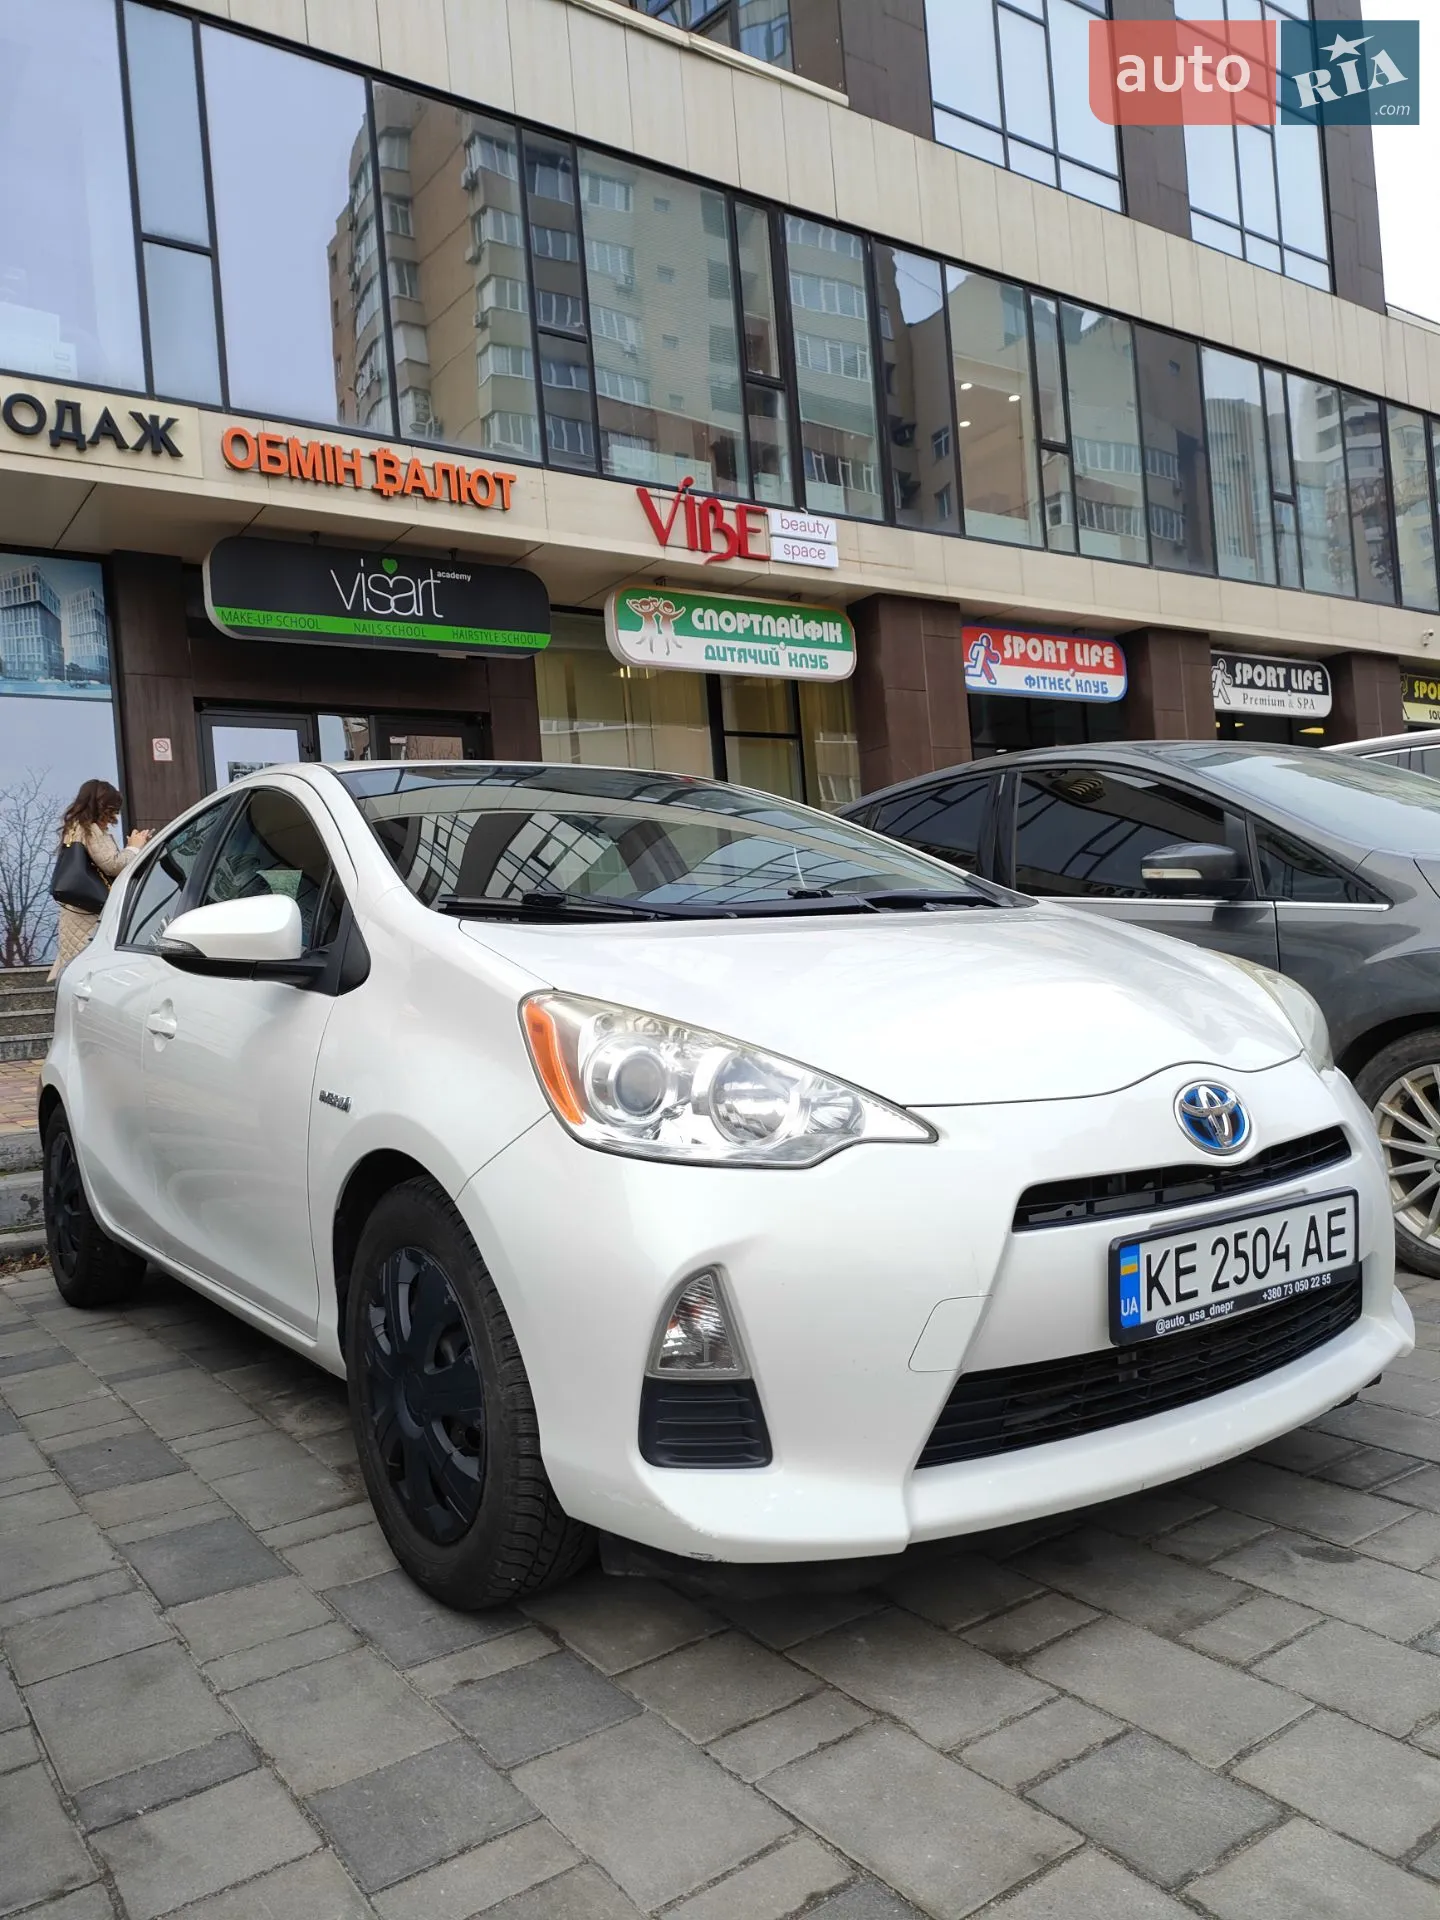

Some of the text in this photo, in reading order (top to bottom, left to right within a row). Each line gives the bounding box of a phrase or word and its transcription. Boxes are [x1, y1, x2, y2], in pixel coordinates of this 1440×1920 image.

[221, 426, 363, 489] ОБМІН
[780, 515, 830, 539] beauty
[783, 542, 827, 560] space
[330, 558, 445, 619] visart
[436, 570, 472, 583] academy
[221, 611, 321, 630] MAKE-UP SCHOOL
[353, 623, 427, 638] NAILS SCHOOL
[691, 607, 843, 644] СПОРТЛАЙФІК
[452, 629, 539, 645] HAIRSTYLE SCHOOL
[704, 644, 829, 670] ДИТЯЧИЙ КЛУБ
[1003, 634, 1116, 669] SPORT LIFE
[1024, 674, 1109, 694] ФІТНЕС КЛУБ
[1235, 662, 1323, 692] SPORT LIFE
[1242, 692, 1285, 708] Premium
[1297, 697, 1316, 710] SPA
[1146, 1207, 1347, 1312] KE 2504 AE
[1262, 1273, 1331, 1301] +380 73 050 22 55
[1120, 1296, 1139, 1316] UA
[1155, 1301, 1235, 1335] @auto_usa_dnepr
